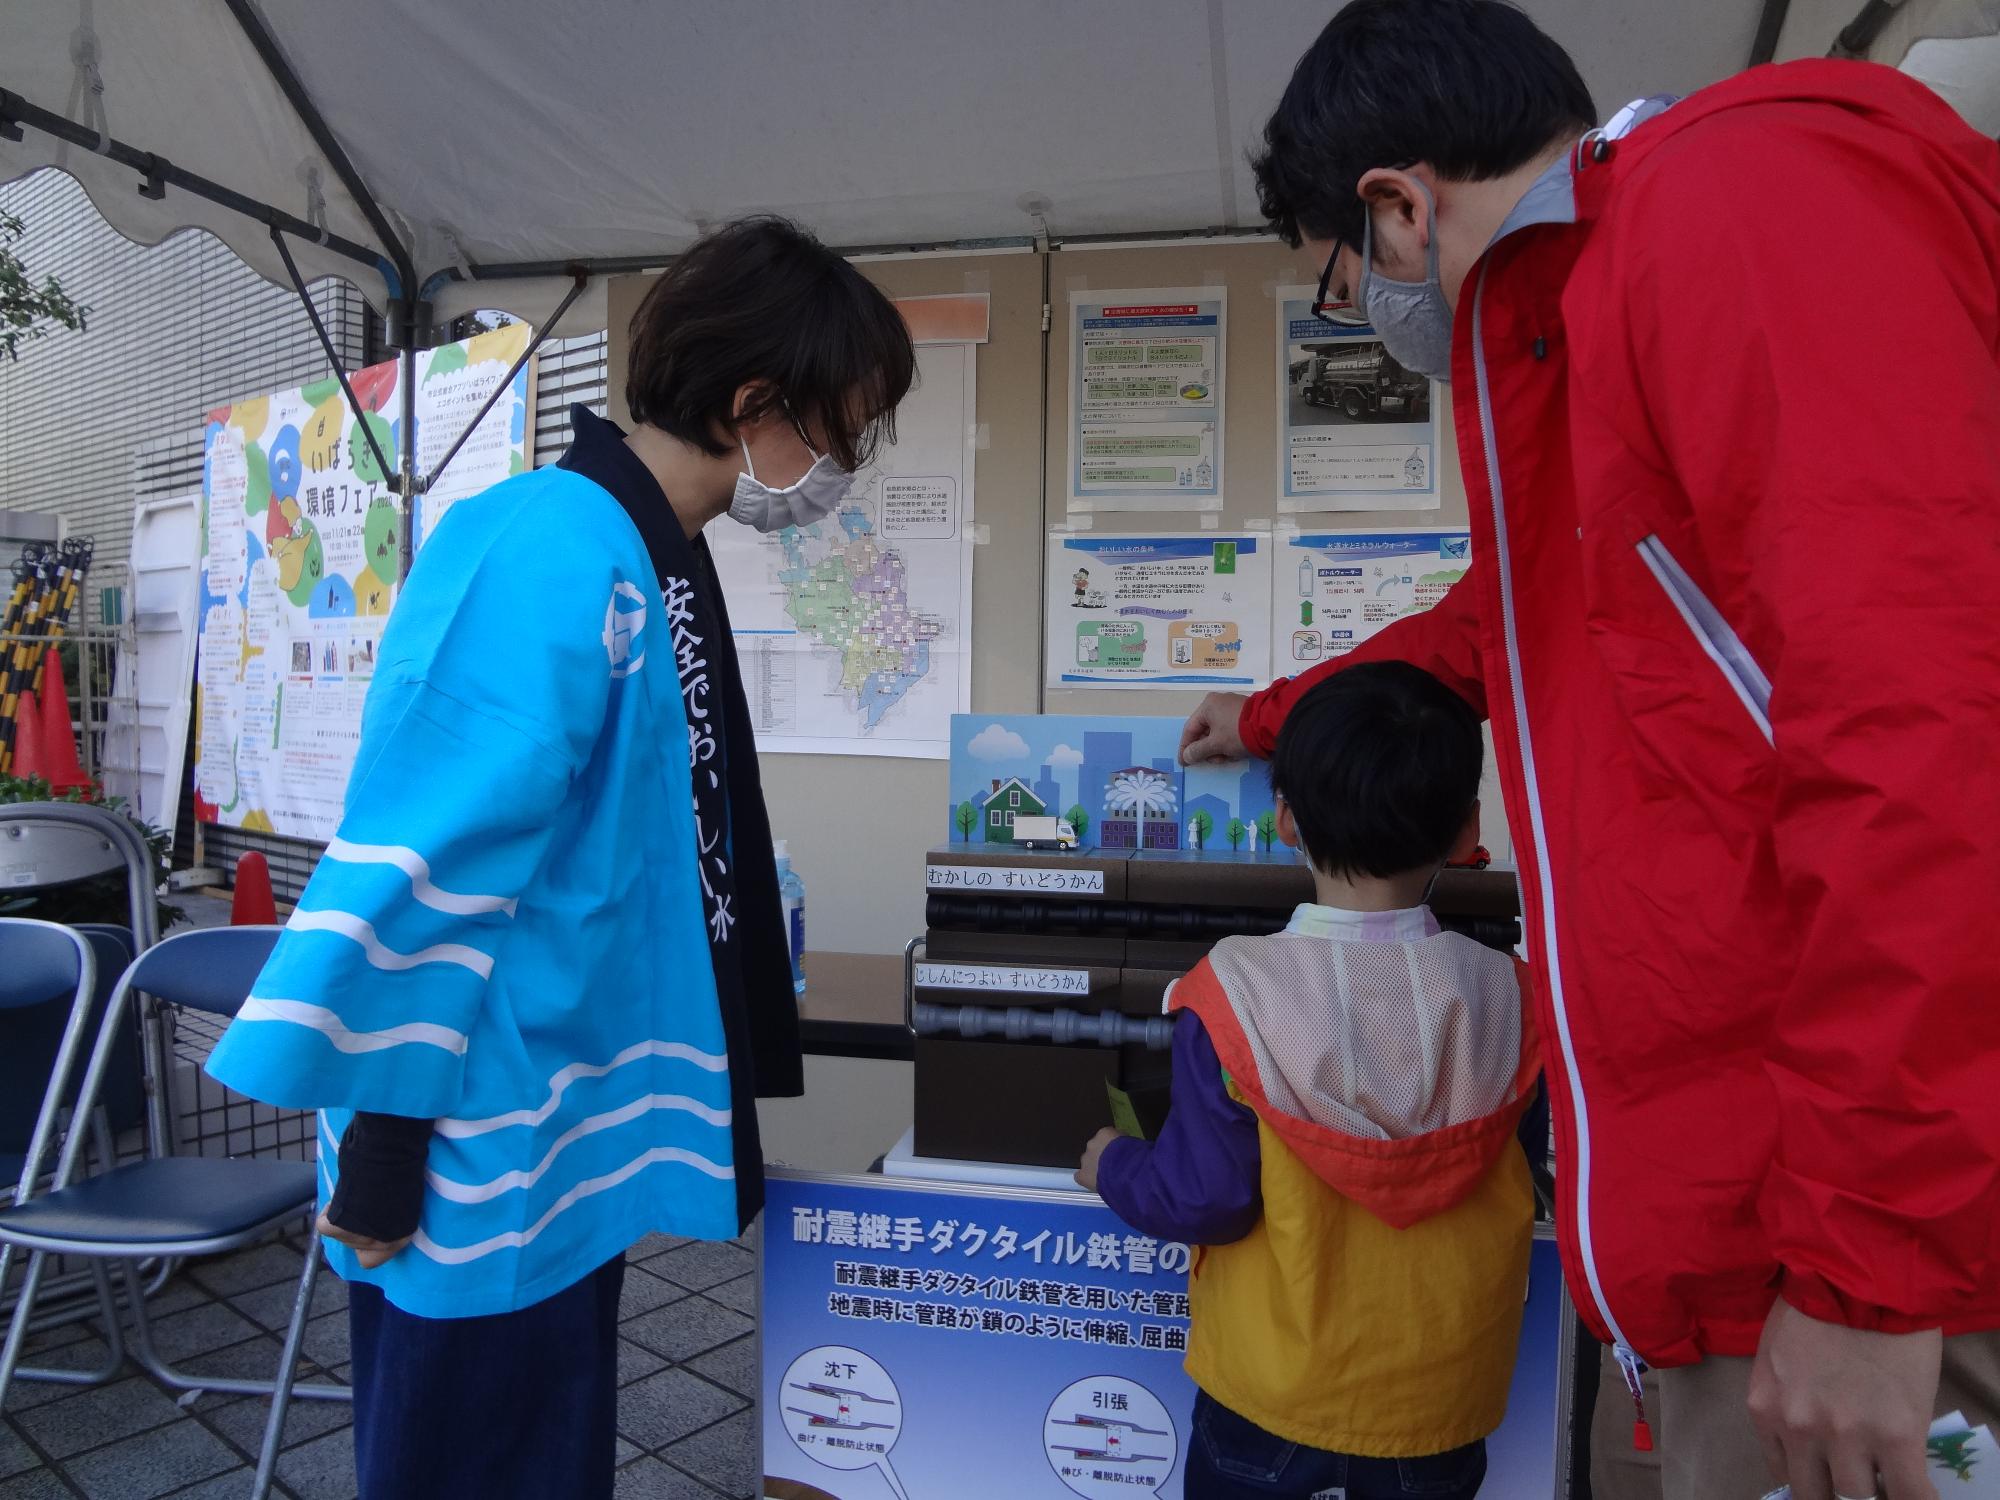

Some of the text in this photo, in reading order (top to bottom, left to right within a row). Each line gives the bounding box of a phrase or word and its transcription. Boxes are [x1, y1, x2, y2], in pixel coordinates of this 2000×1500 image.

[306, 480, 378, 518] 環境フェア
[927, 868, 1103, 890] むかしの すいどうかん
[915, 967, 1087, 991] じしんにつよい すいどうかん
[792, 1206, 1191, 1275] 耐震継手ダクタイル鉄管の
[824, 1360, 858, 1380] 沈下
[1092, 1390, 1129, 1411] 引張
[797, 1432, 885, 1454] 曲げ・離脱防止状態
[1060, 1466, 1157, 1488] 伸び・離脱防止状態
